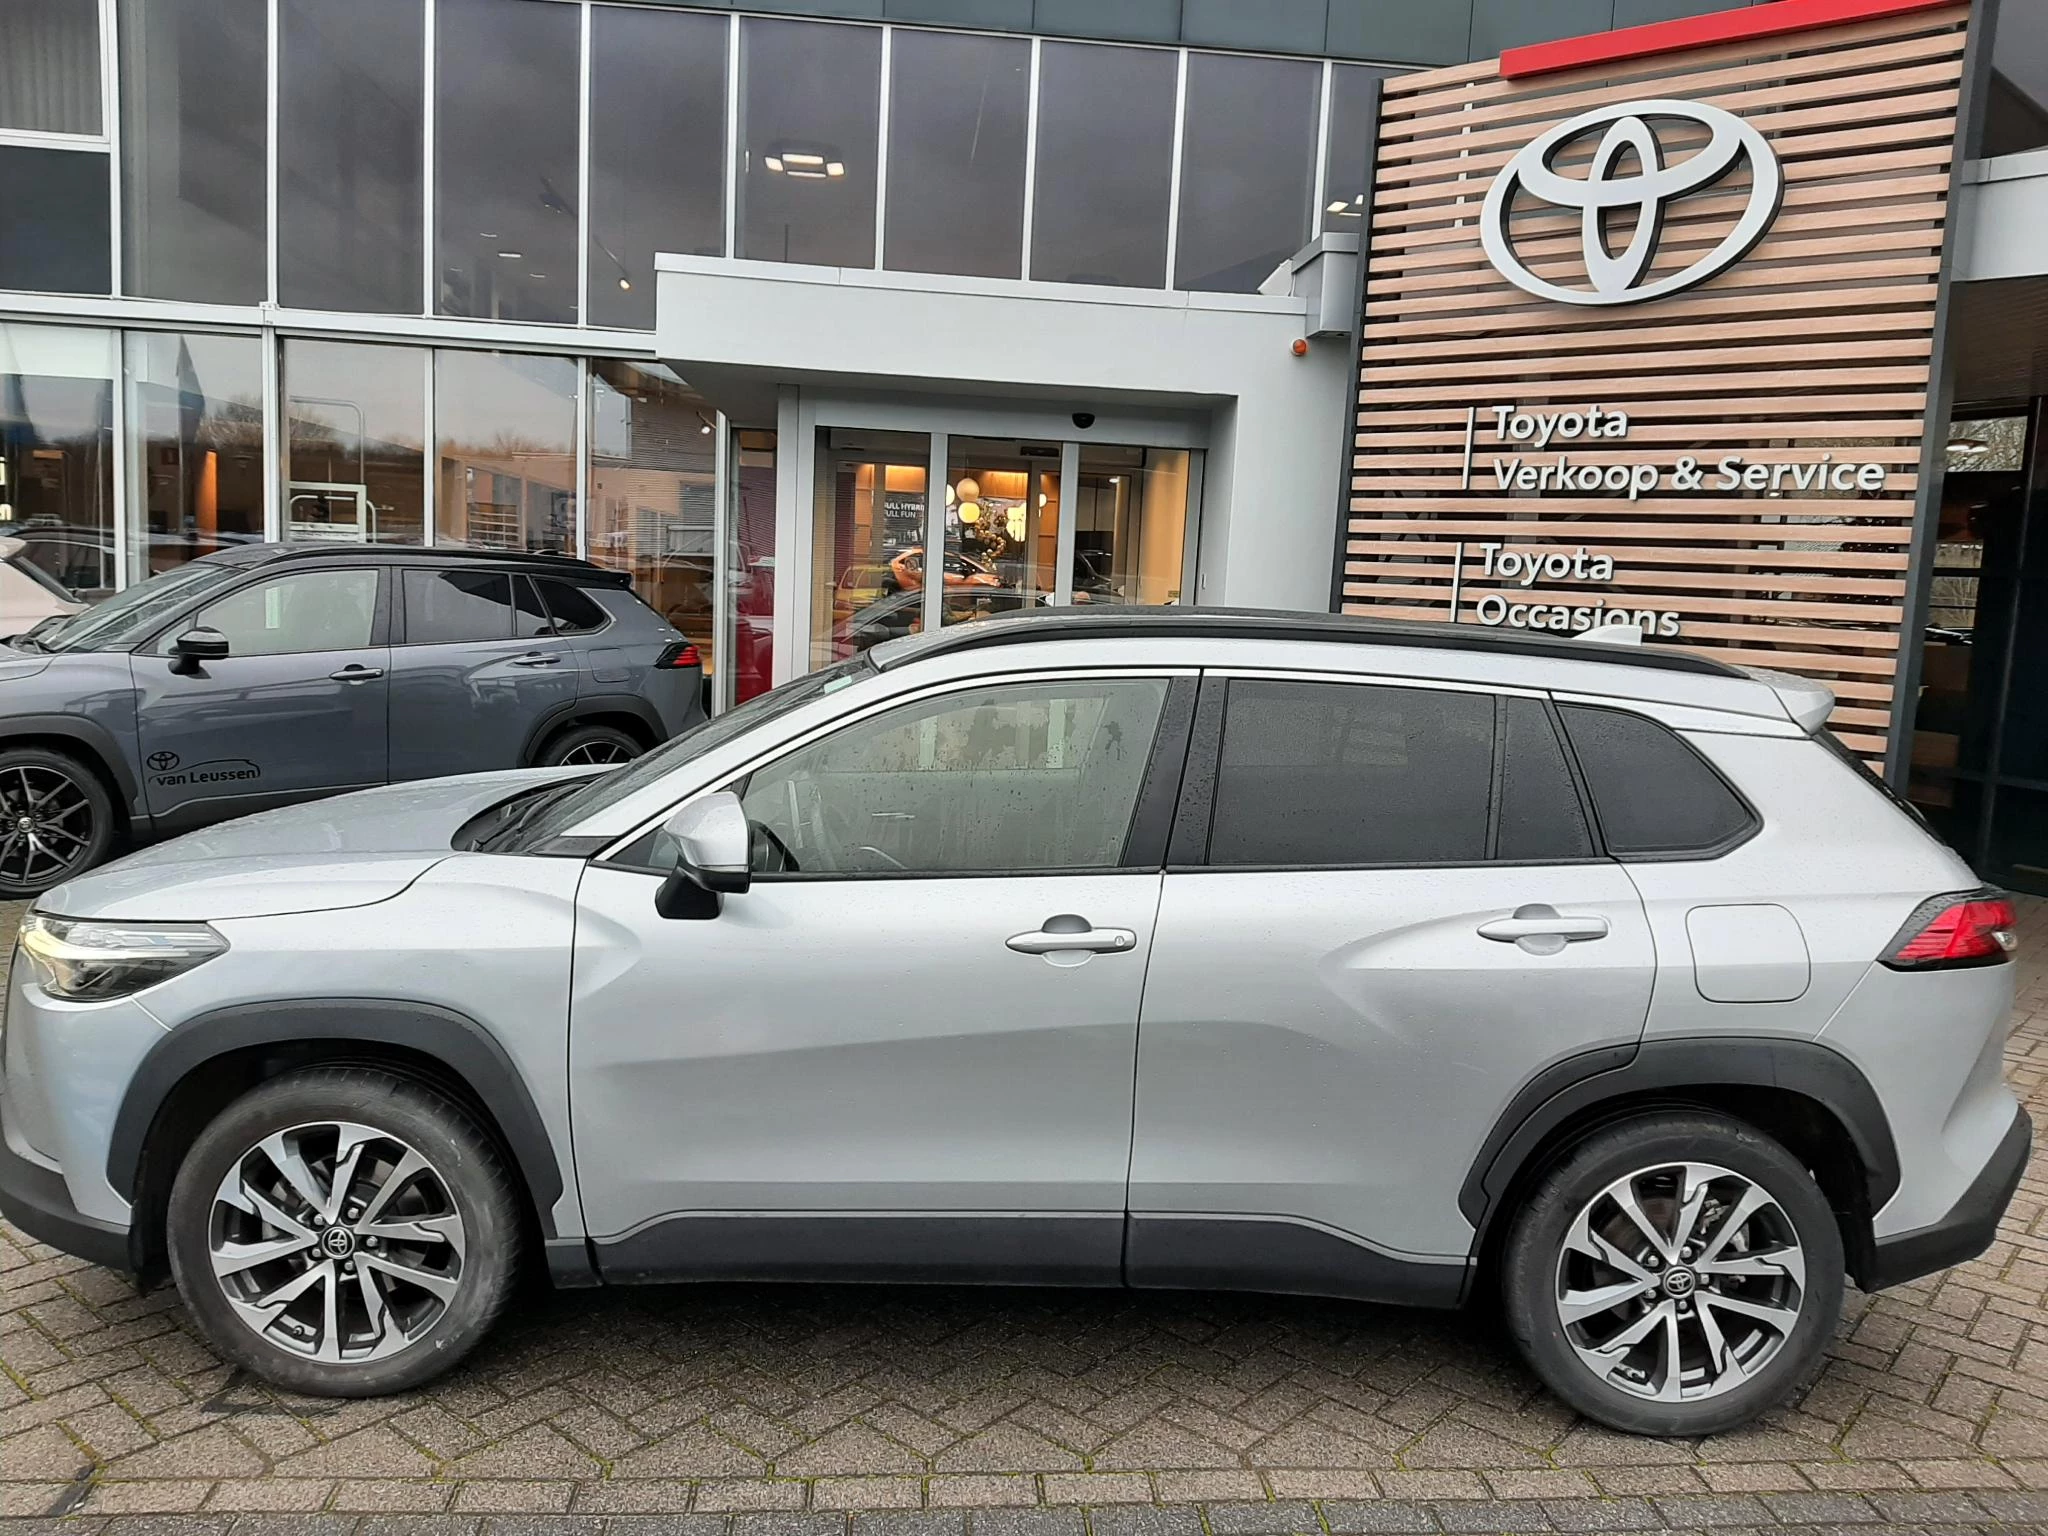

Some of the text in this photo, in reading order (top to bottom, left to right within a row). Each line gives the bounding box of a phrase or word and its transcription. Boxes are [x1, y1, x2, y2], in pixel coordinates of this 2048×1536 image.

[1492, 405, 1629, 448] Toyota
[1493, 453, 1886, 500] Verkoop & Service
[901, 510, 916, 518] FUN
[1480, 542, 1615, 586] Toyota
[1476, 594, 1680, 637] Occasions
[157, 769, 256, 786] van Leussen
